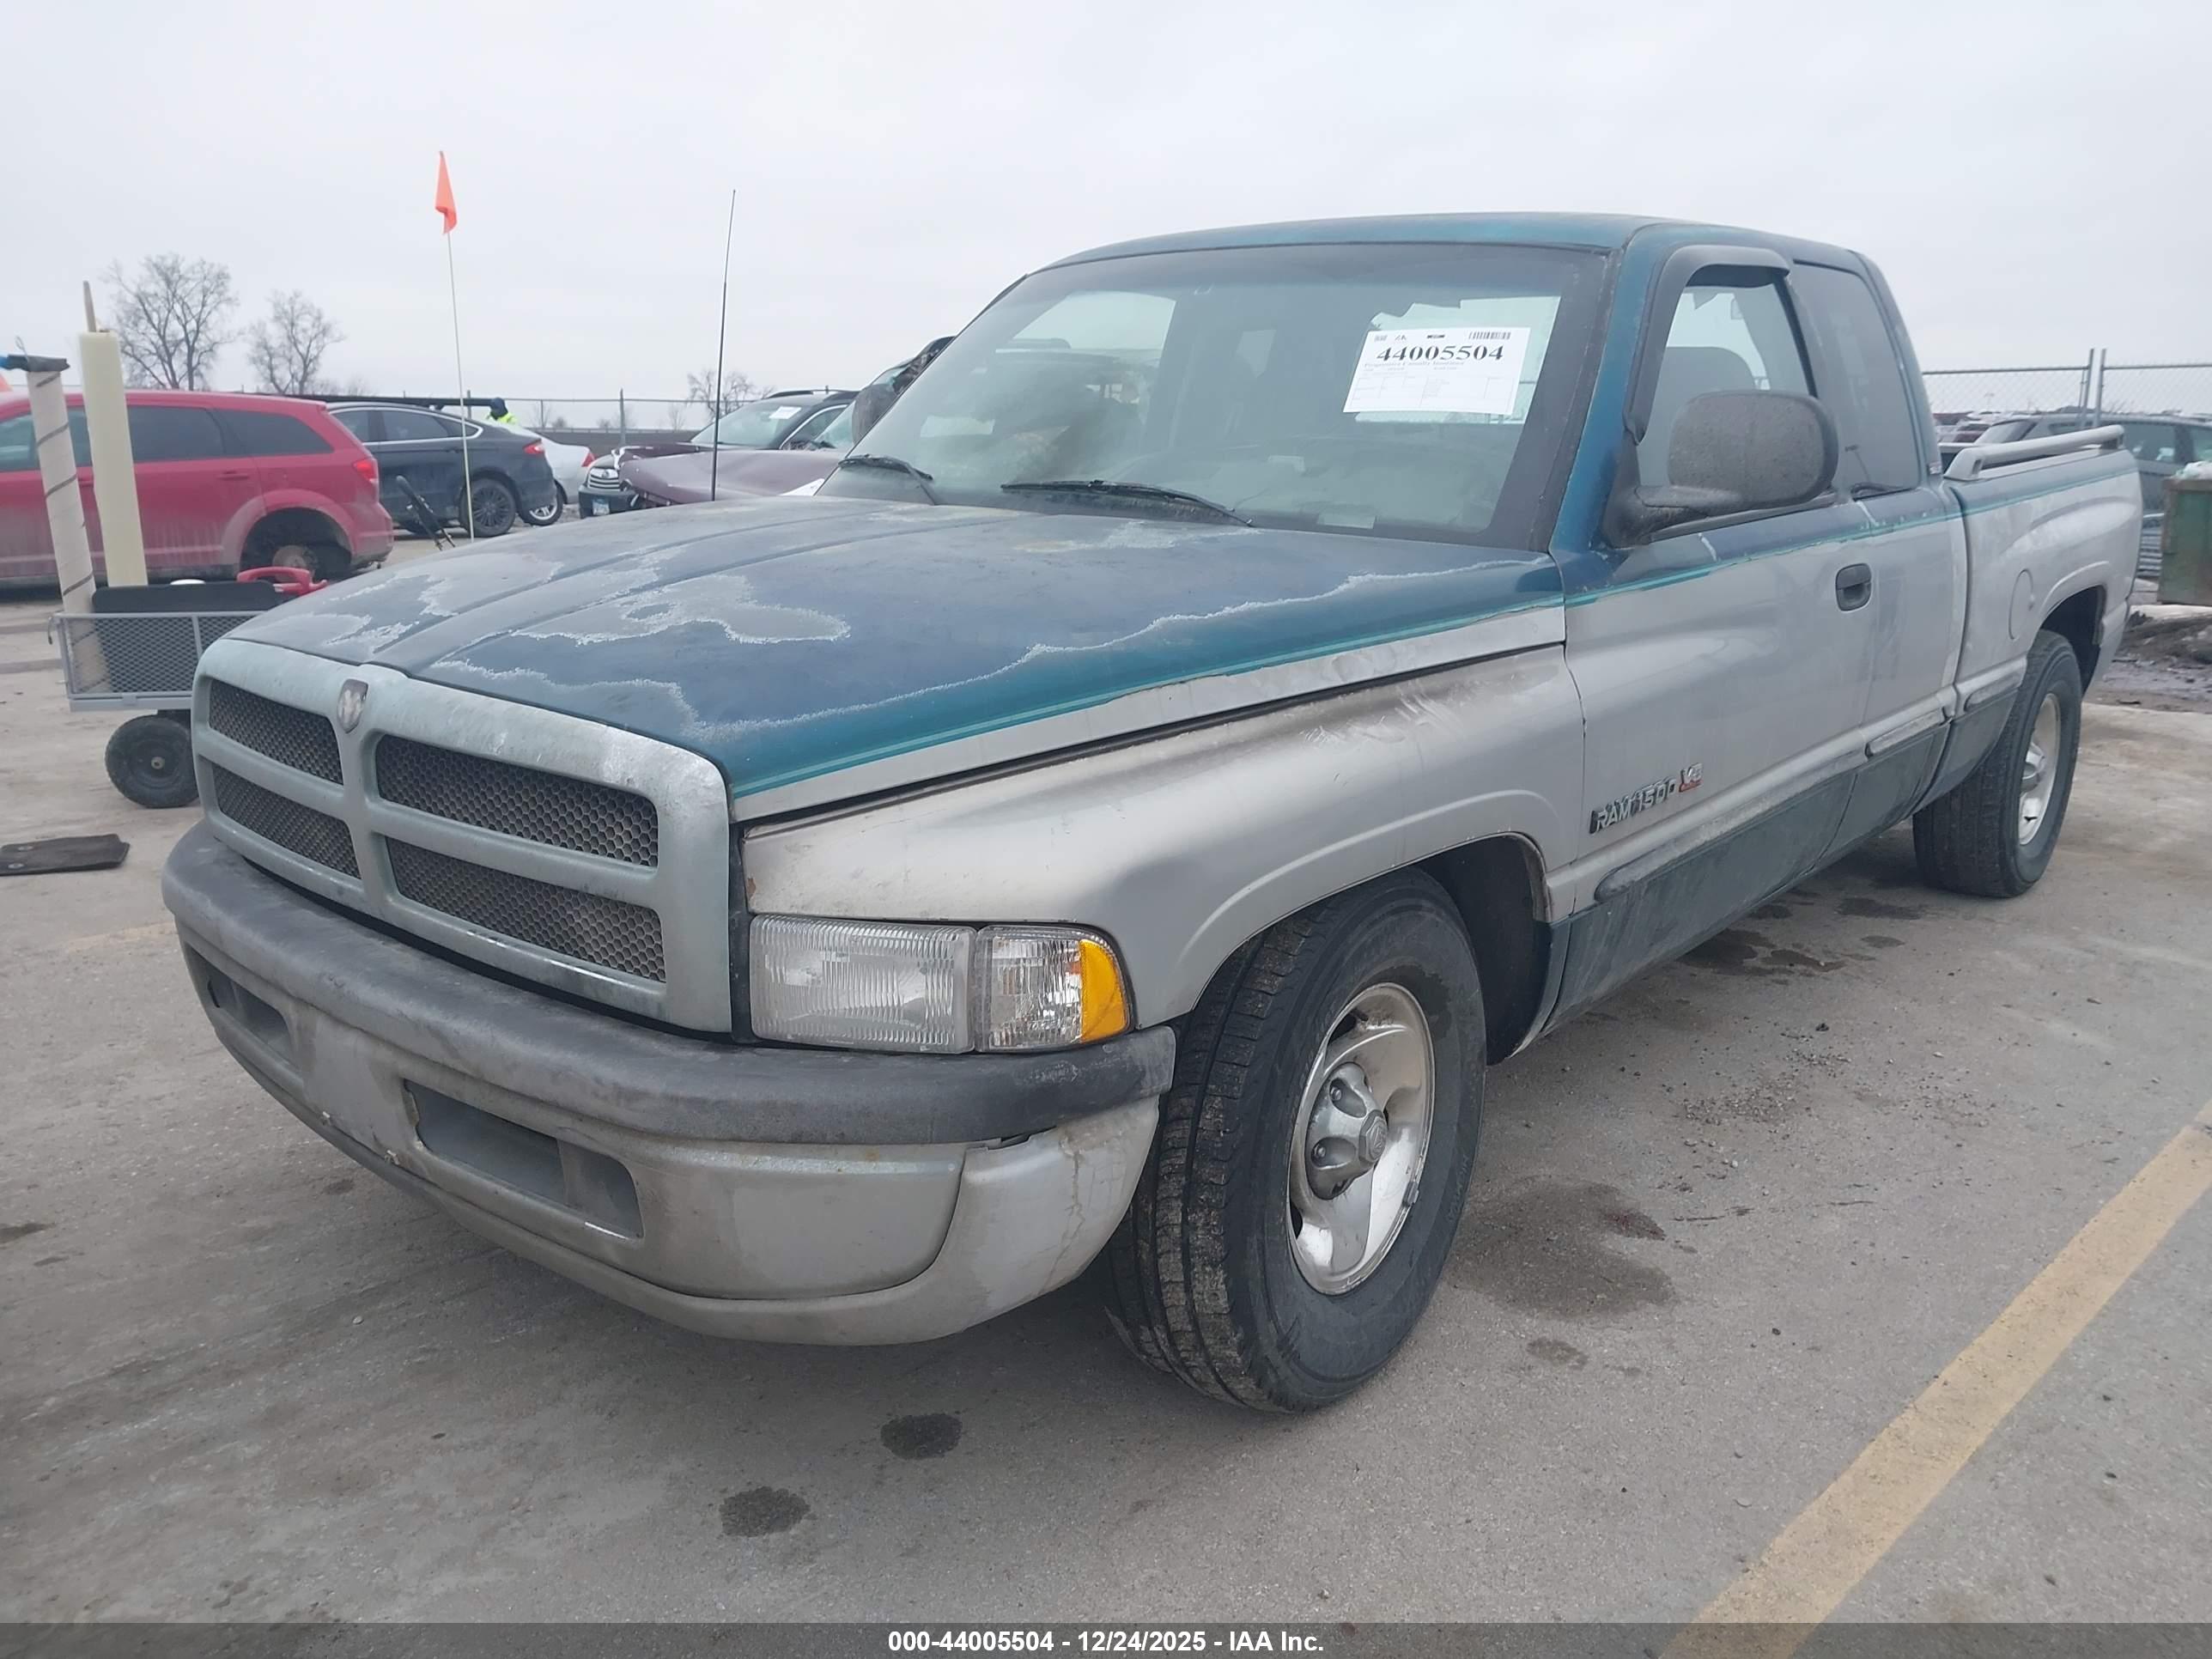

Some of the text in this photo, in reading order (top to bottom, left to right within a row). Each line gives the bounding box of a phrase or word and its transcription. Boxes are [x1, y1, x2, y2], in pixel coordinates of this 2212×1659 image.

[1376, 345, 1504, 361] 44005504
[1589, 795, 1634, 835] RAM
[1632, 775, 1677, 812] 1500
